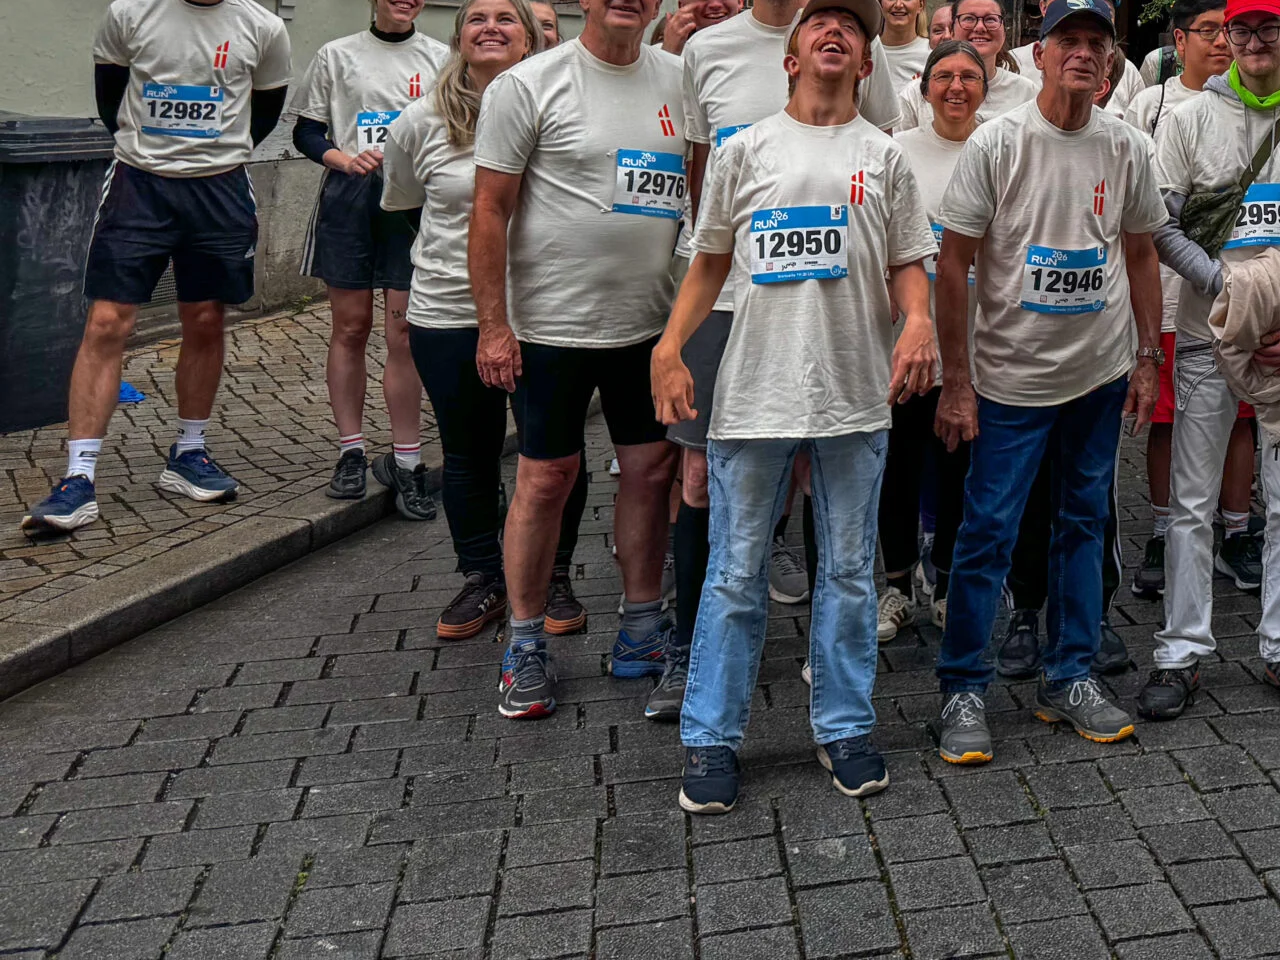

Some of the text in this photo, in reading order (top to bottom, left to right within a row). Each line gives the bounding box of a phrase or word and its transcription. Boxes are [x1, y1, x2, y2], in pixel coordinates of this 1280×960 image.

[146, 90, 168, 98] RUN
[147, 100, 216, 120] 12982
[622, 157, 647, 167] RUN
[624, 169, 685, 199] 12976
[754, 219, 777, 230] RUN
[755, 228, 841, 259] 12950
[1031, 255, 1057, 266] RUN
[1031, 267, 1103, 294] 12946
